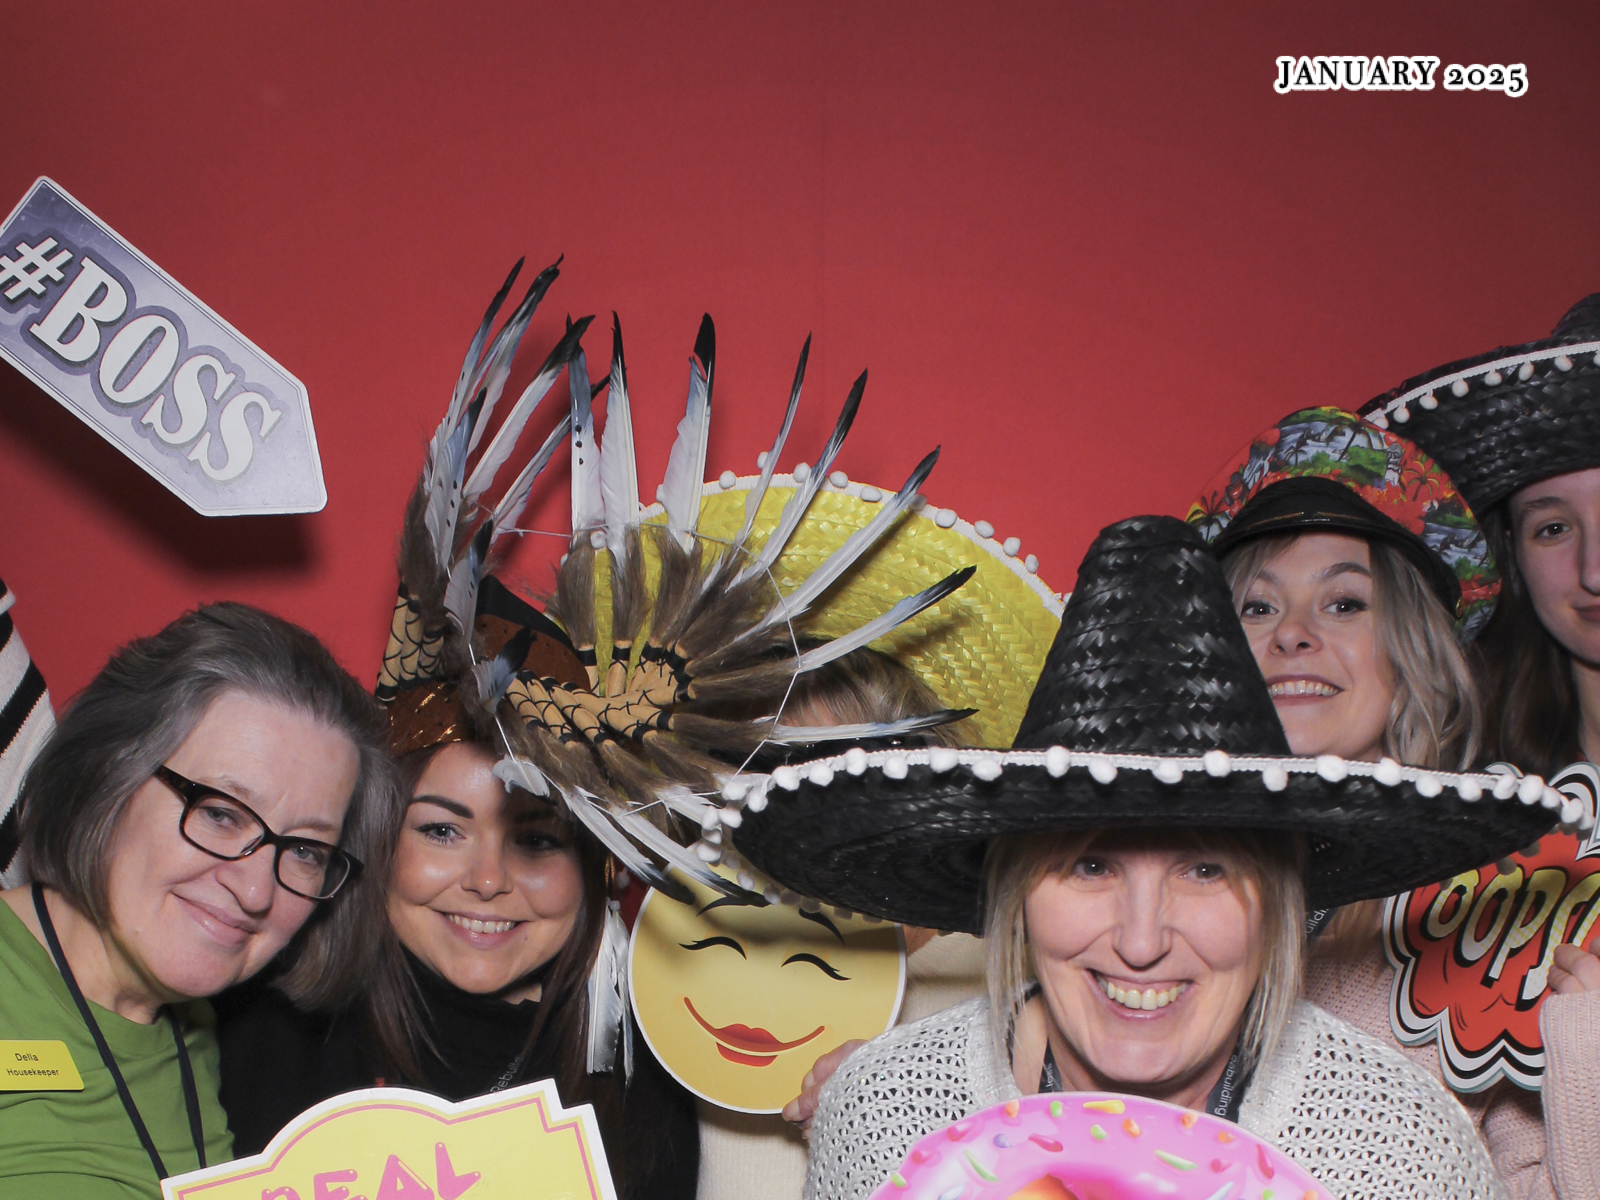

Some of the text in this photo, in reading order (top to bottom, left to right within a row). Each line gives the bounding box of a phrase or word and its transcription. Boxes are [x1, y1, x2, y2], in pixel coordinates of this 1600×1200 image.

[0, 237, 282, 482] #BOSS
[14, 1052, 39, 1062] Della
[6, 1068, 59, 1077] Housekeeper
